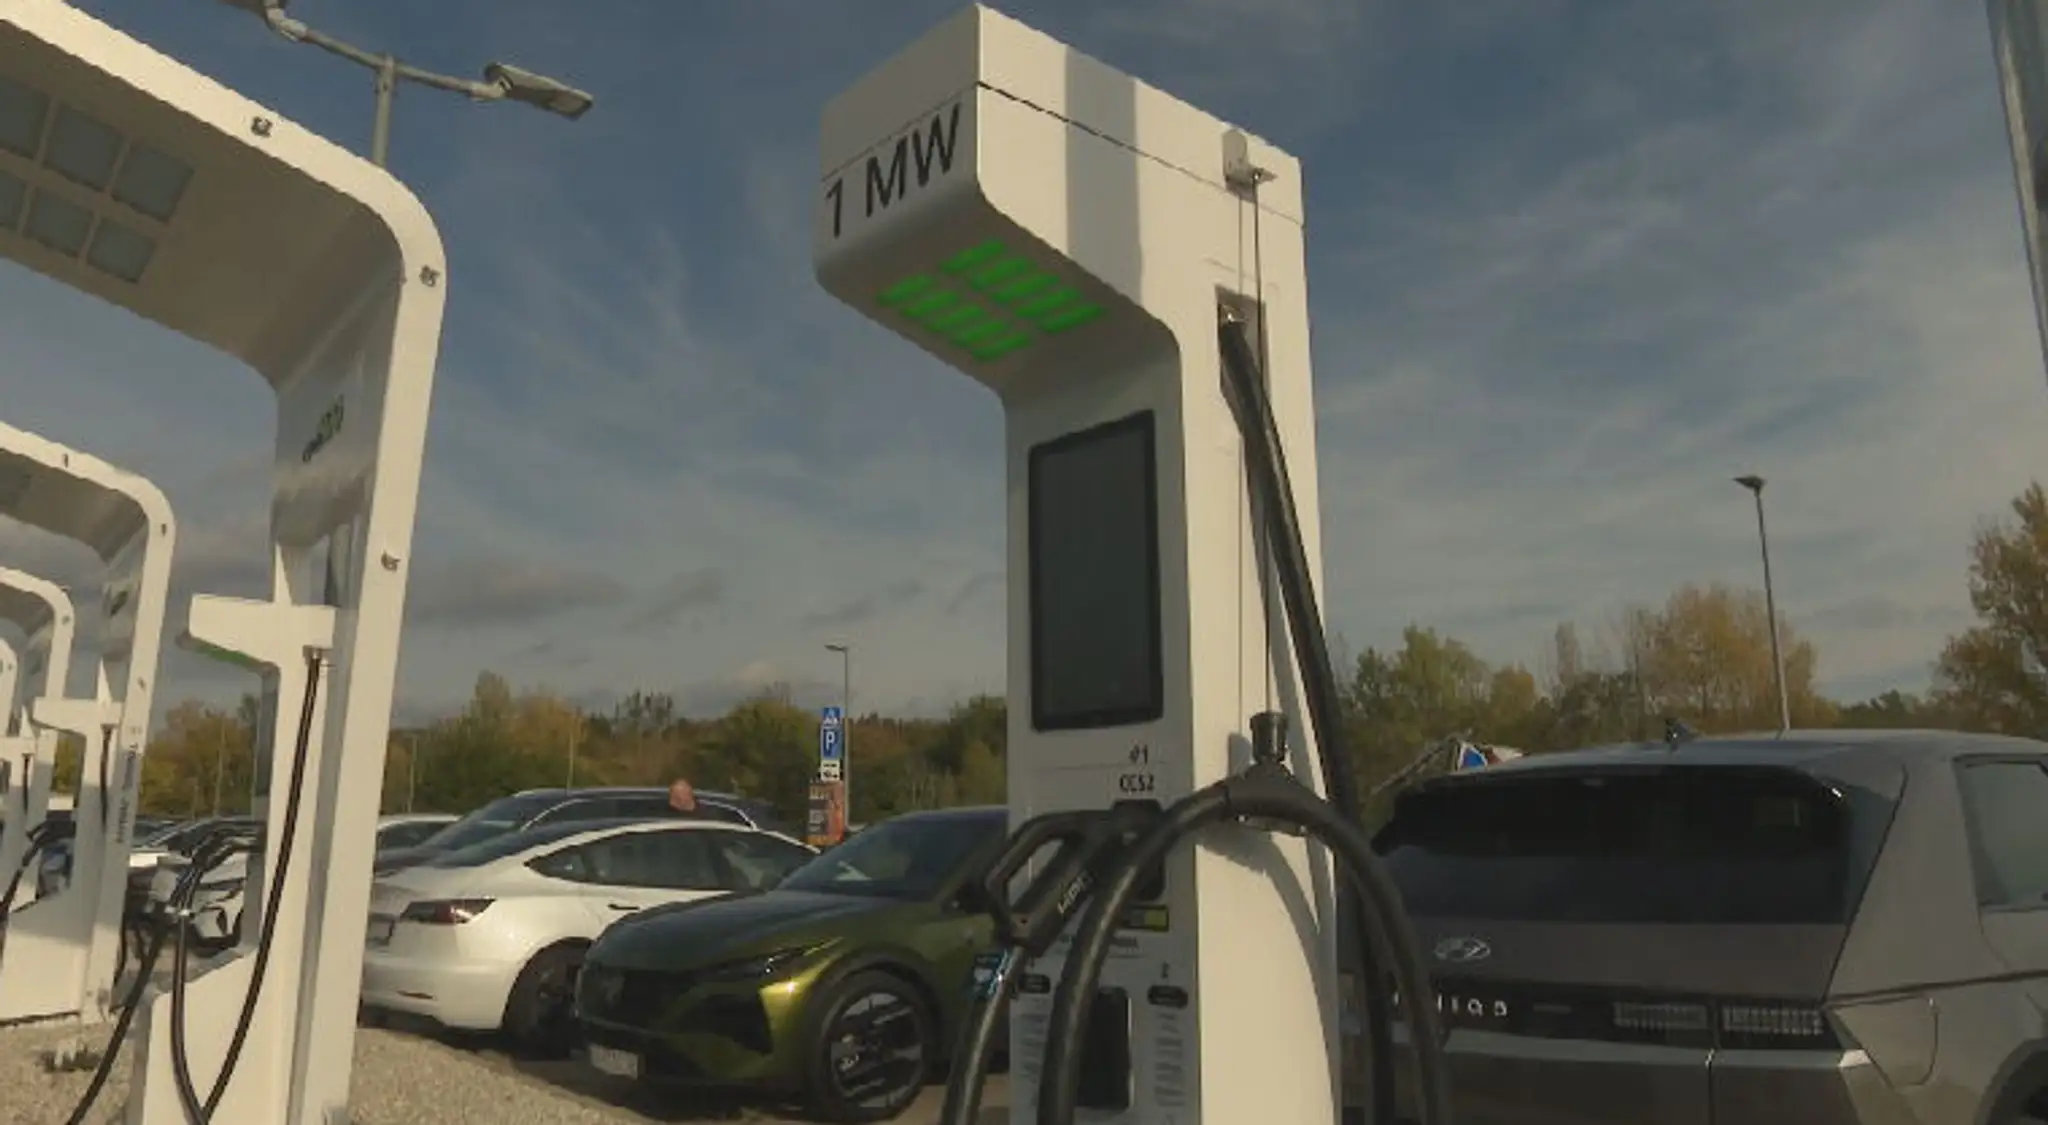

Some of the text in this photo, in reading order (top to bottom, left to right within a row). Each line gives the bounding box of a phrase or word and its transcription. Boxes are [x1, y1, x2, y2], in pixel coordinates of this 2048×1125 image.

[825, 102, 961, 238] 1 MW
[825, 731, 836, 751] P
